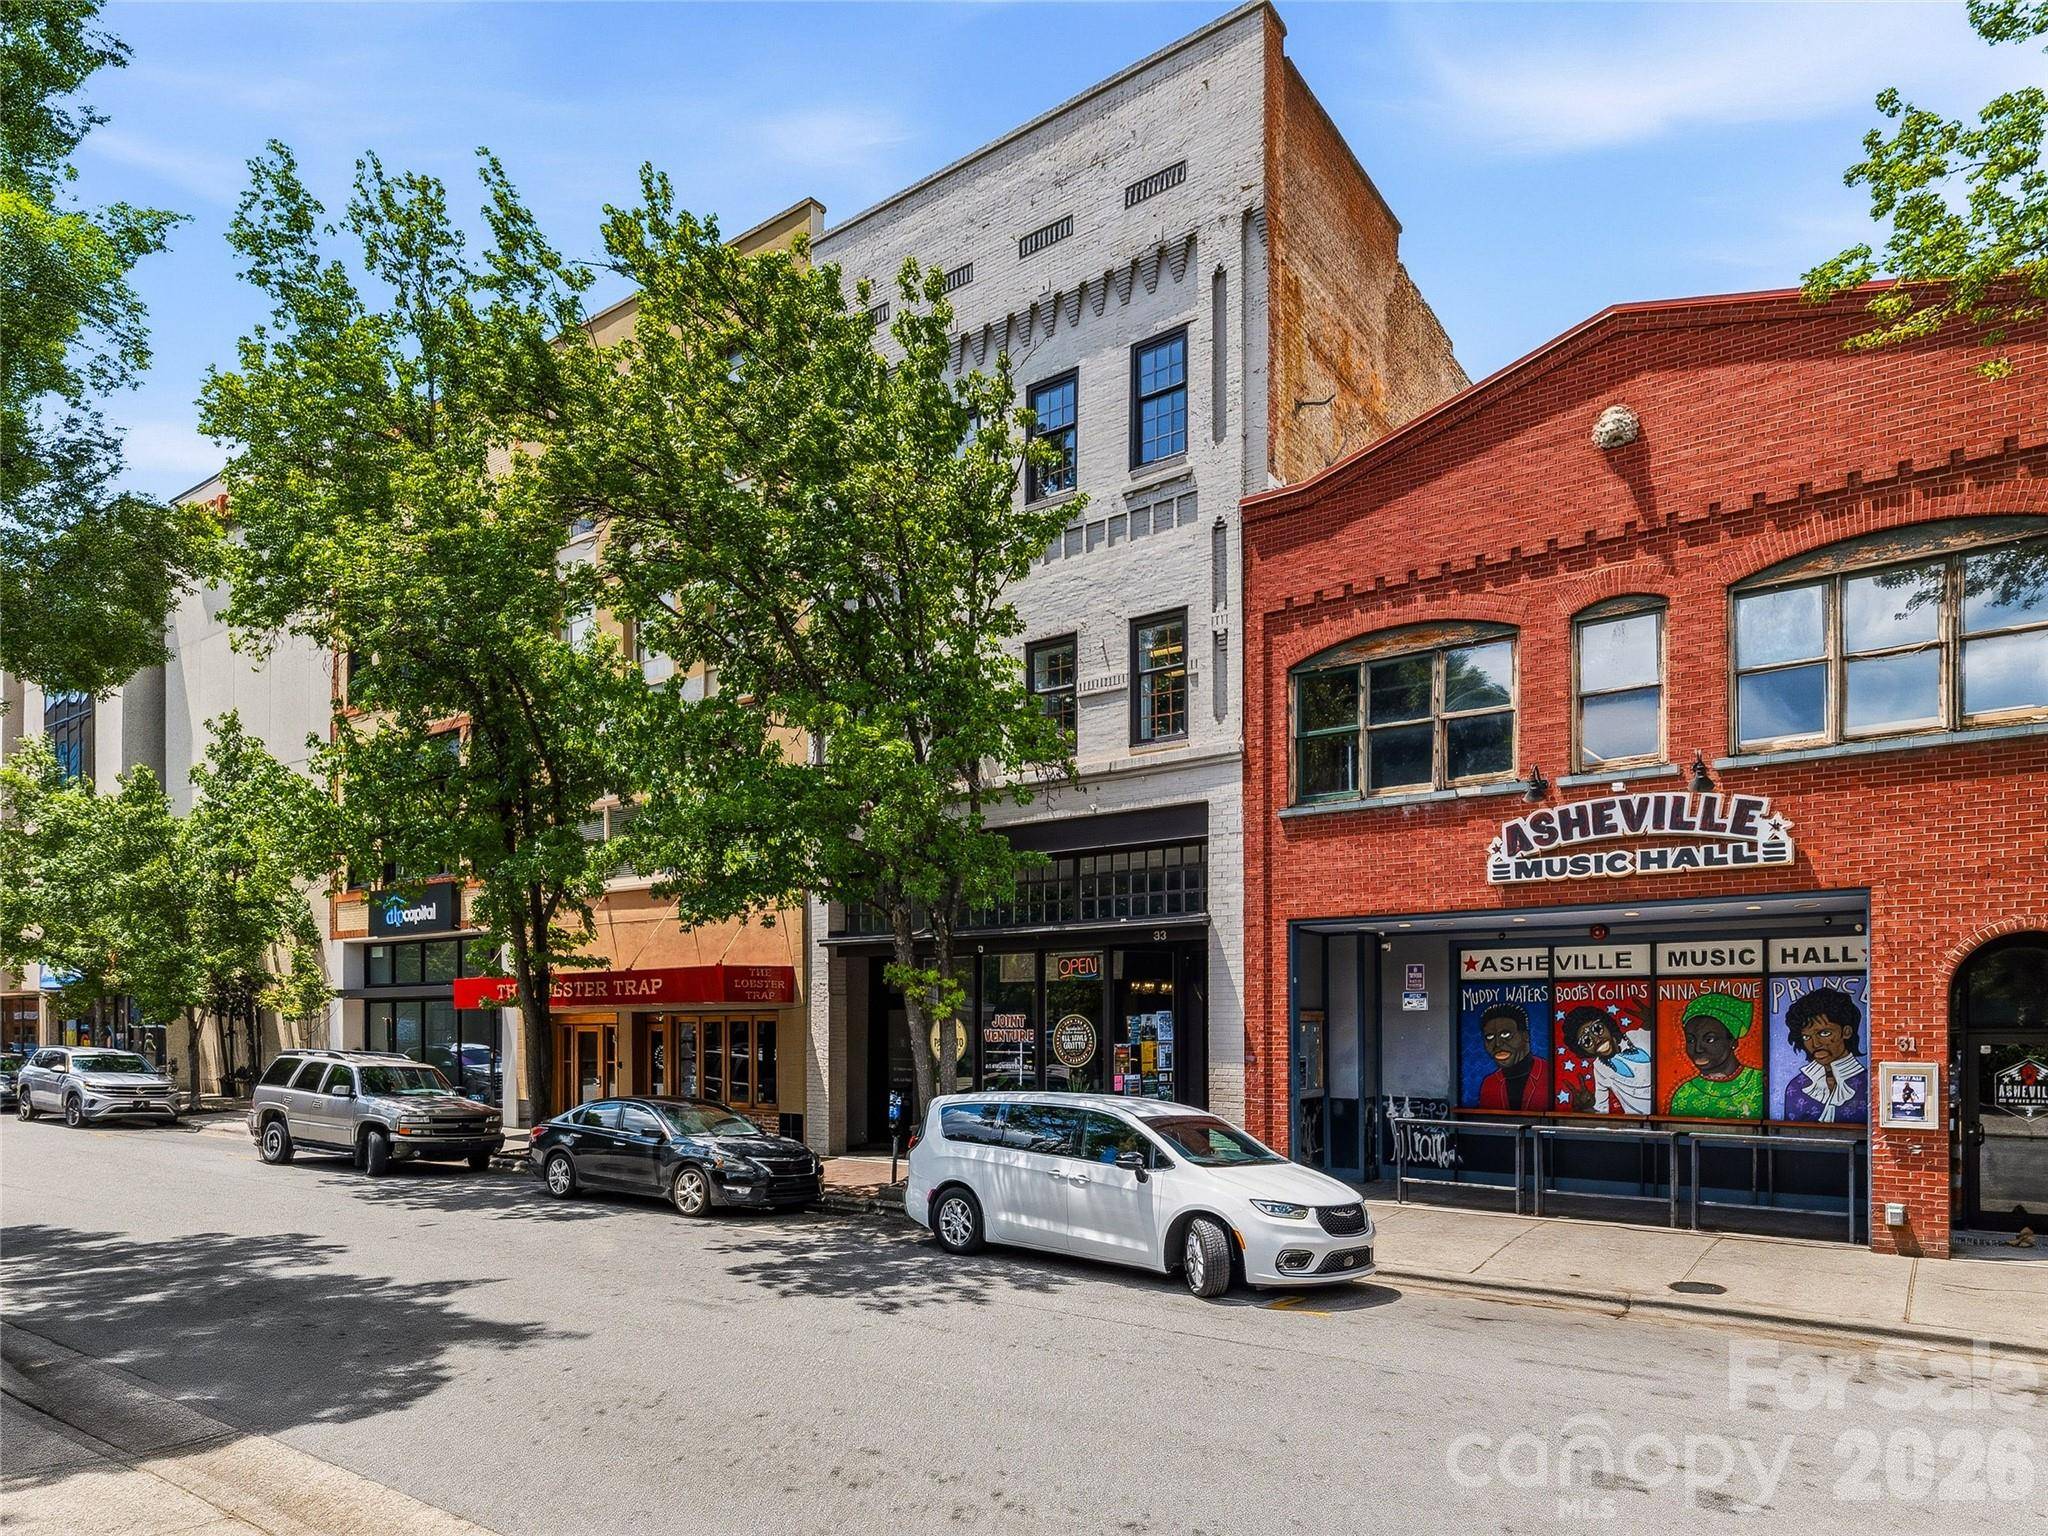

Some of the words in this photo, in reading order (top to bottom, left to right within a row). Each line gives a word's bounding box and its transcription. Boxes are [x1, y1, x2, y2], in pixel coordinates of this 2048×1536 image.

[1506, 795, 1763, 856] ASHEVILLE
[1515, 852, 1626, 879] MUSIC
[1639, 842, 1758, 869] HALL
[1153, 930, 1167, 941] 33
[1059, 957, 1097, 974] OPEN
[1480, 951, 1632, 972] ASHEVILLE
[1668, 949, 1756, 967] MUSIC
[1781, 946, 1858, 964] HALL
[749, 967, 771, 976] THE
[497, 983, 518, 1000] TH
[613, 978, 663, 996] TRAP
[734, 979, 784, 989] LOBSTER
[1659, 982, 1698, 1001] NINA
[745, 991, 775, 1000] TRAP
[1462, 987, 1500, 1011] MUDDY
[1506, 985, 1549, 1002] WATERS
[992, 1014, 1026, 1028] JOINT
[984, 1029, 1034, 1043] VENTURE
[1898, 1036, 1917, 1053] 31
